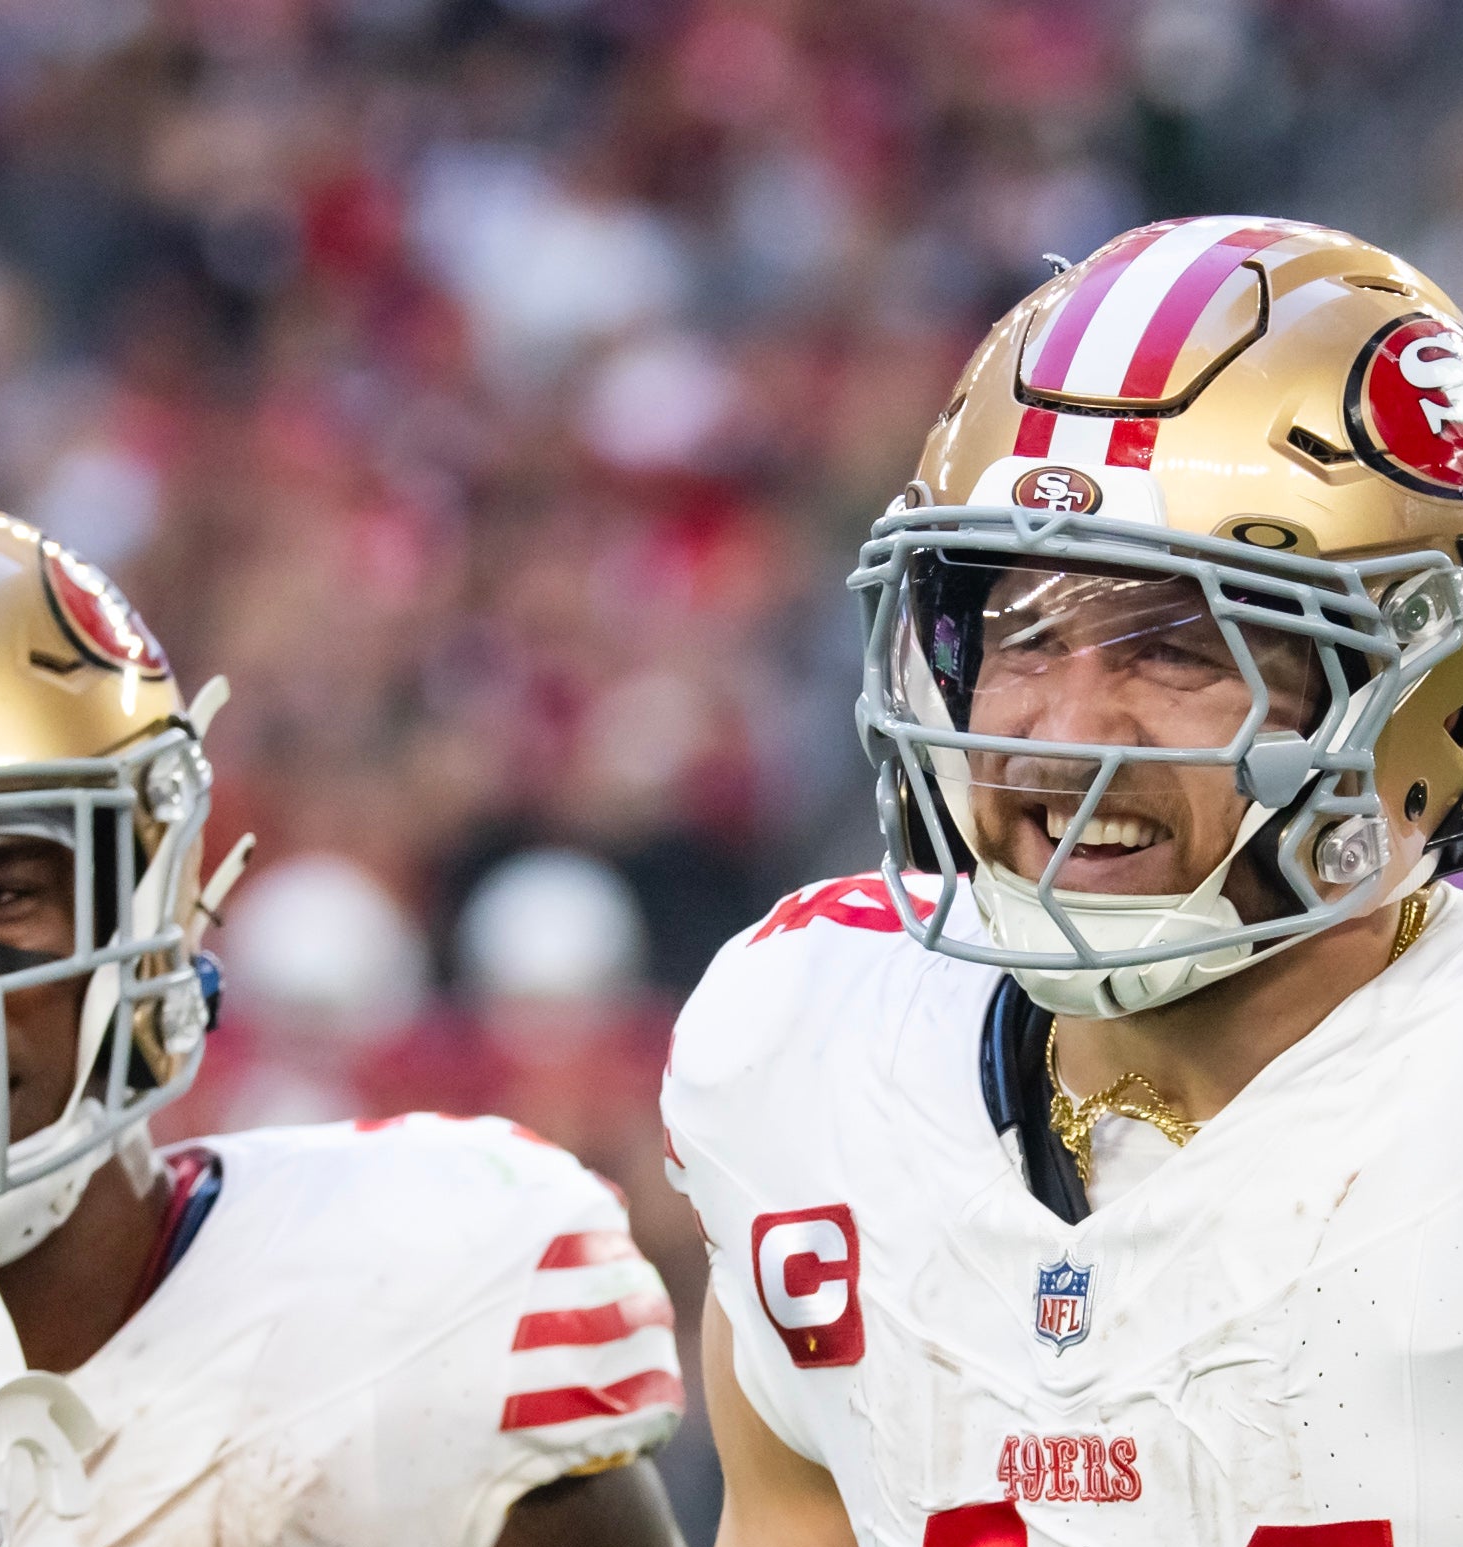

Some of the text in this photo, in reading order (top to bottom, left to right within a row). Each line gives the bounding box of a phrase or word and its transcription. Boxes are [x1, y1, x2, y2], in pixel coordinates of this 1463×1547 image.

[758, 1218, 849, 1330] C
[1040, 1298, 1080, 1336] NFL
[997, 1434, 1142, 1503] 49ERS
